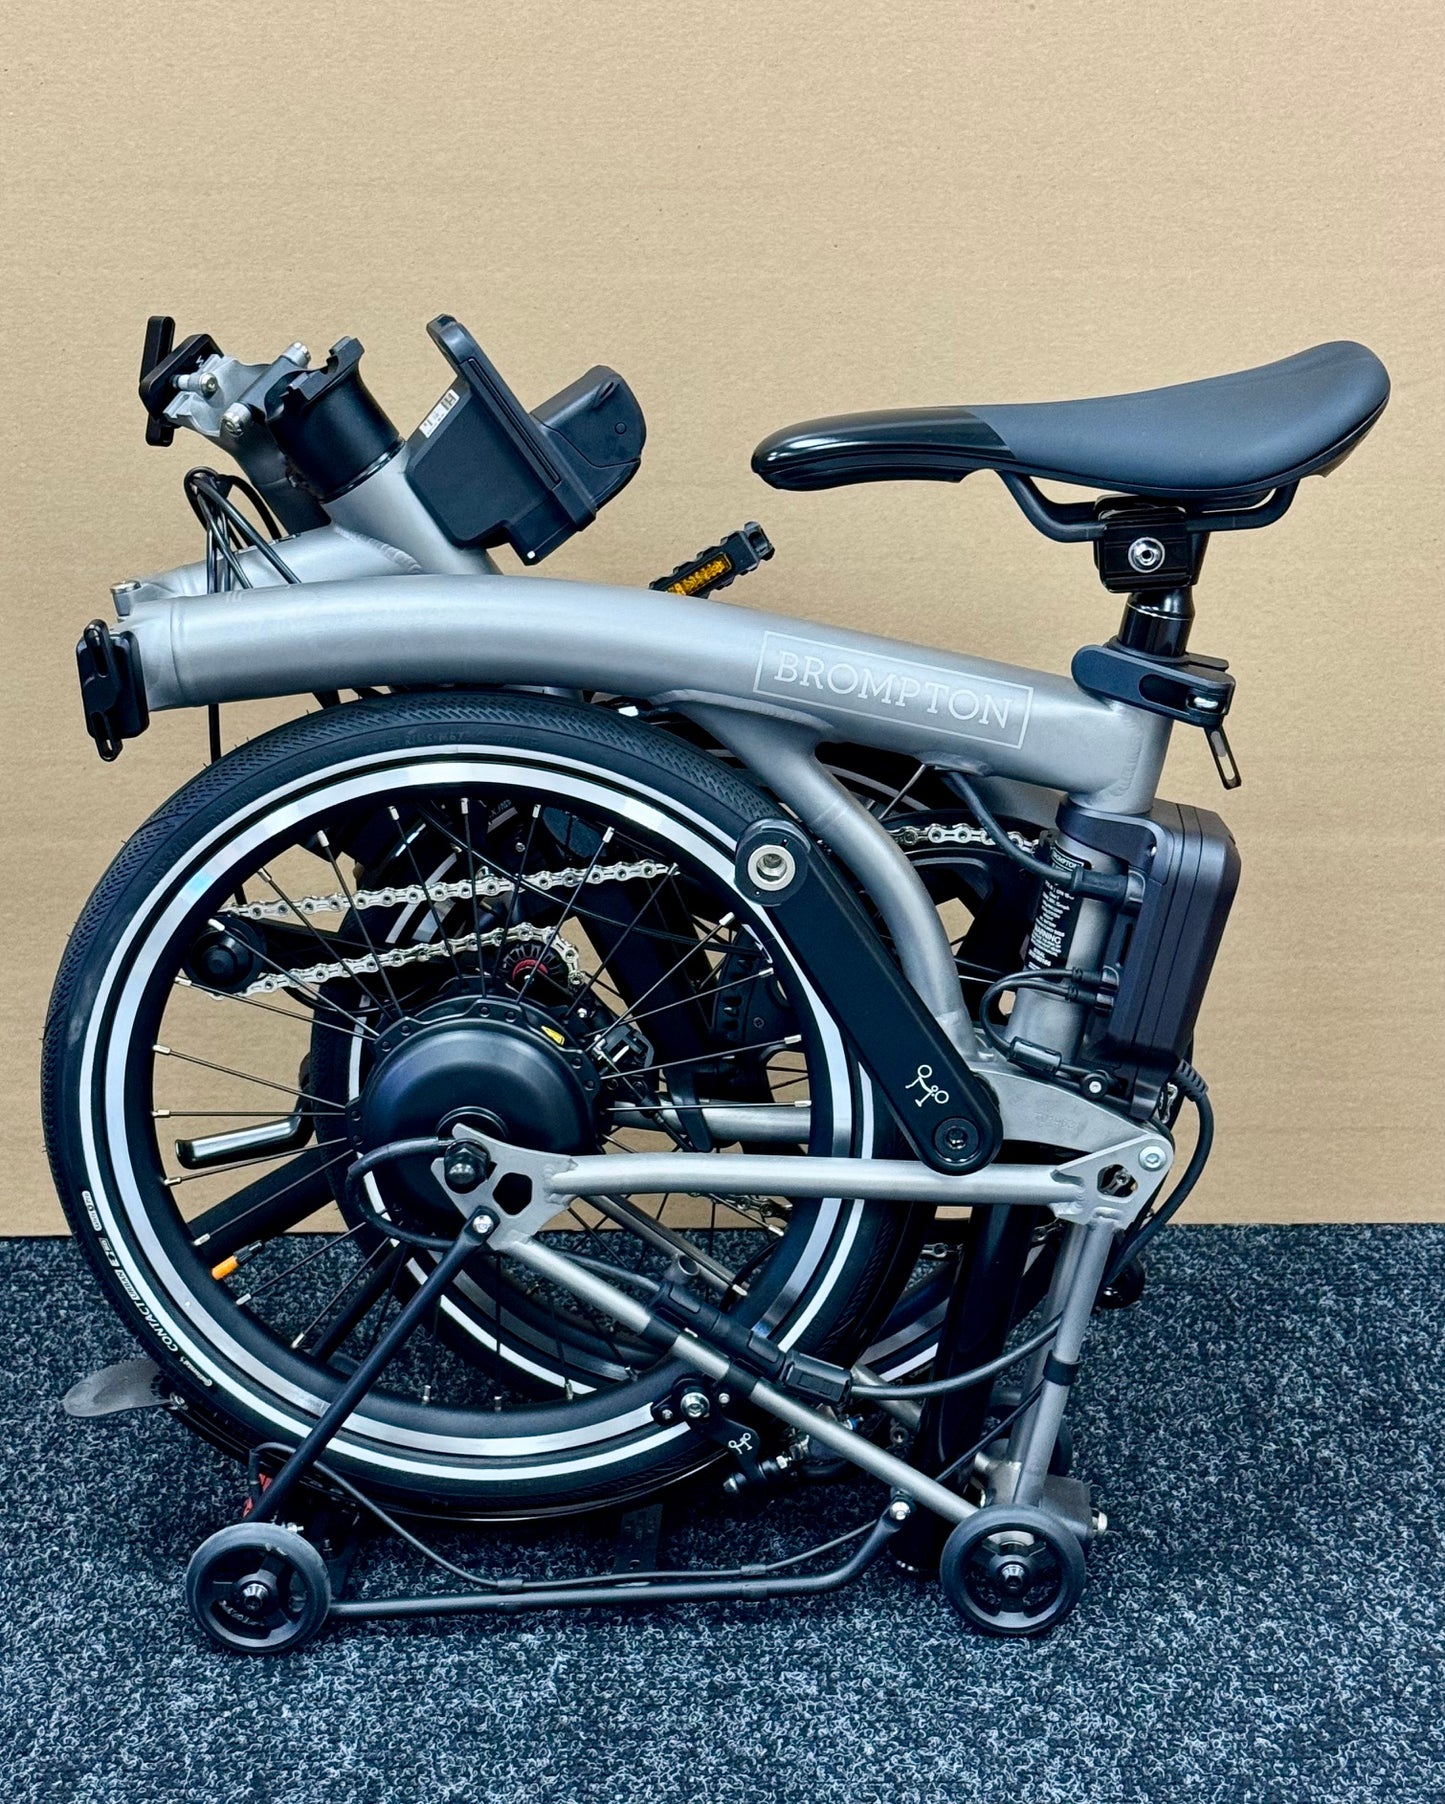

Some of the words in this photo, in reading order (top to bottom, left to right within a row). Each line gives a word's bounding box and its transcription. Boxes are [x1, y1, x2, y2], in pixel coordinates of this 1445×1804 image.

[773, 650, 1013, 729] BROMPTON
[117, 1271, 138, 1299] URBAN
[134, 1301, 179, 1352] CONTACT
